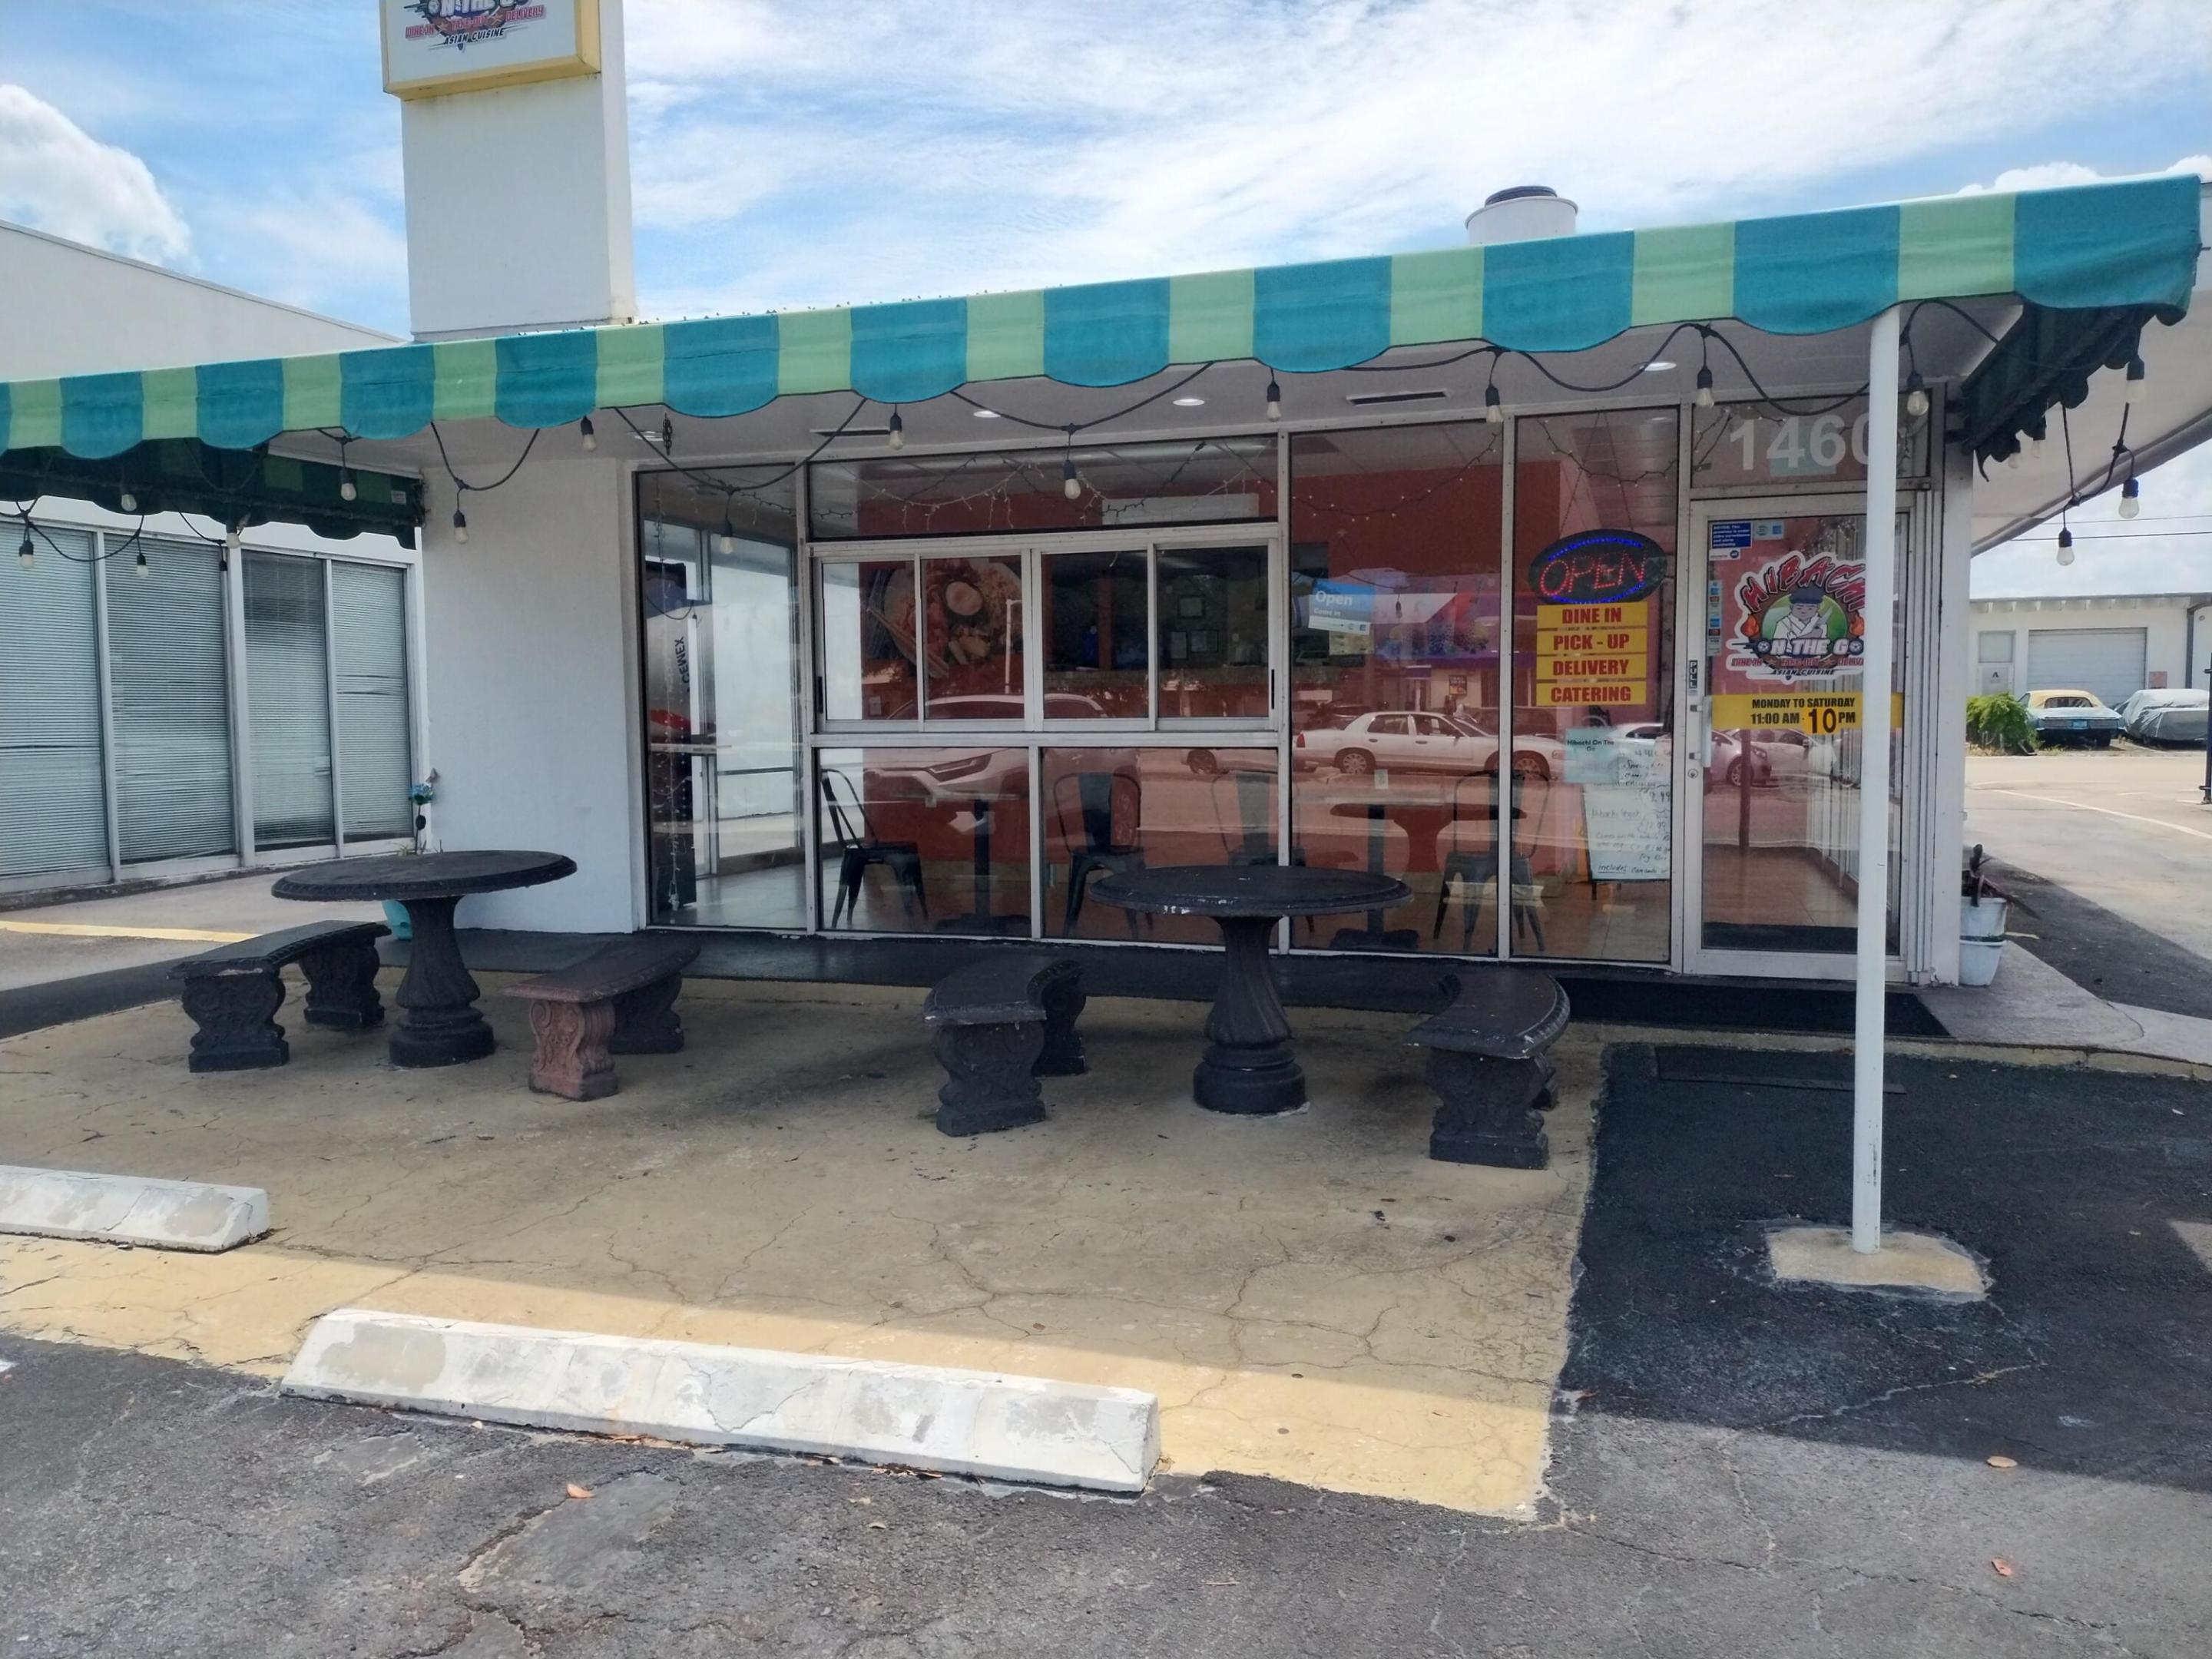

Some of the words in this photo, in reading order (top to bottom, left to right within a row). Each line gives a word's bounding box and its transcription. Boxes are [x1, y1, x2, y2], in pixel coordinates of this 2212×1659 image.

[444, 33, 469, 45] ASIAN
[472, 28, 505, 41] CUISINE
[1540, 551, 1647, 596] OPEN
[1740, 555, 1866, 613] HIBACH
[1316, 591, 1353, 607] Open
[1562, 608, 1600, 624] DINE
[1604, 608, 1622, 623] IN
[1553, 635, 1594, 651] PICK
[1608, 634, 1630, 649] UP
[1791, 637, 1832, 655] THE
[1833, 637, 1865, 656] GO
[1552, 659, 1630, 676] DELIVERY
[1551, 686, 1631, 703] CATERING
[1752, 698, 1790, 709] MONDAY
[1793, 698, 1805, 708] TO
[1806, 697, 1855, 707] SATURDAY
[1751, 713, 1780, 724] 11:00
[1782, 712, 1800, 724] AM
[1808, 708, 1836, 733] 10
[1838, 711, 1856, 724] PM
